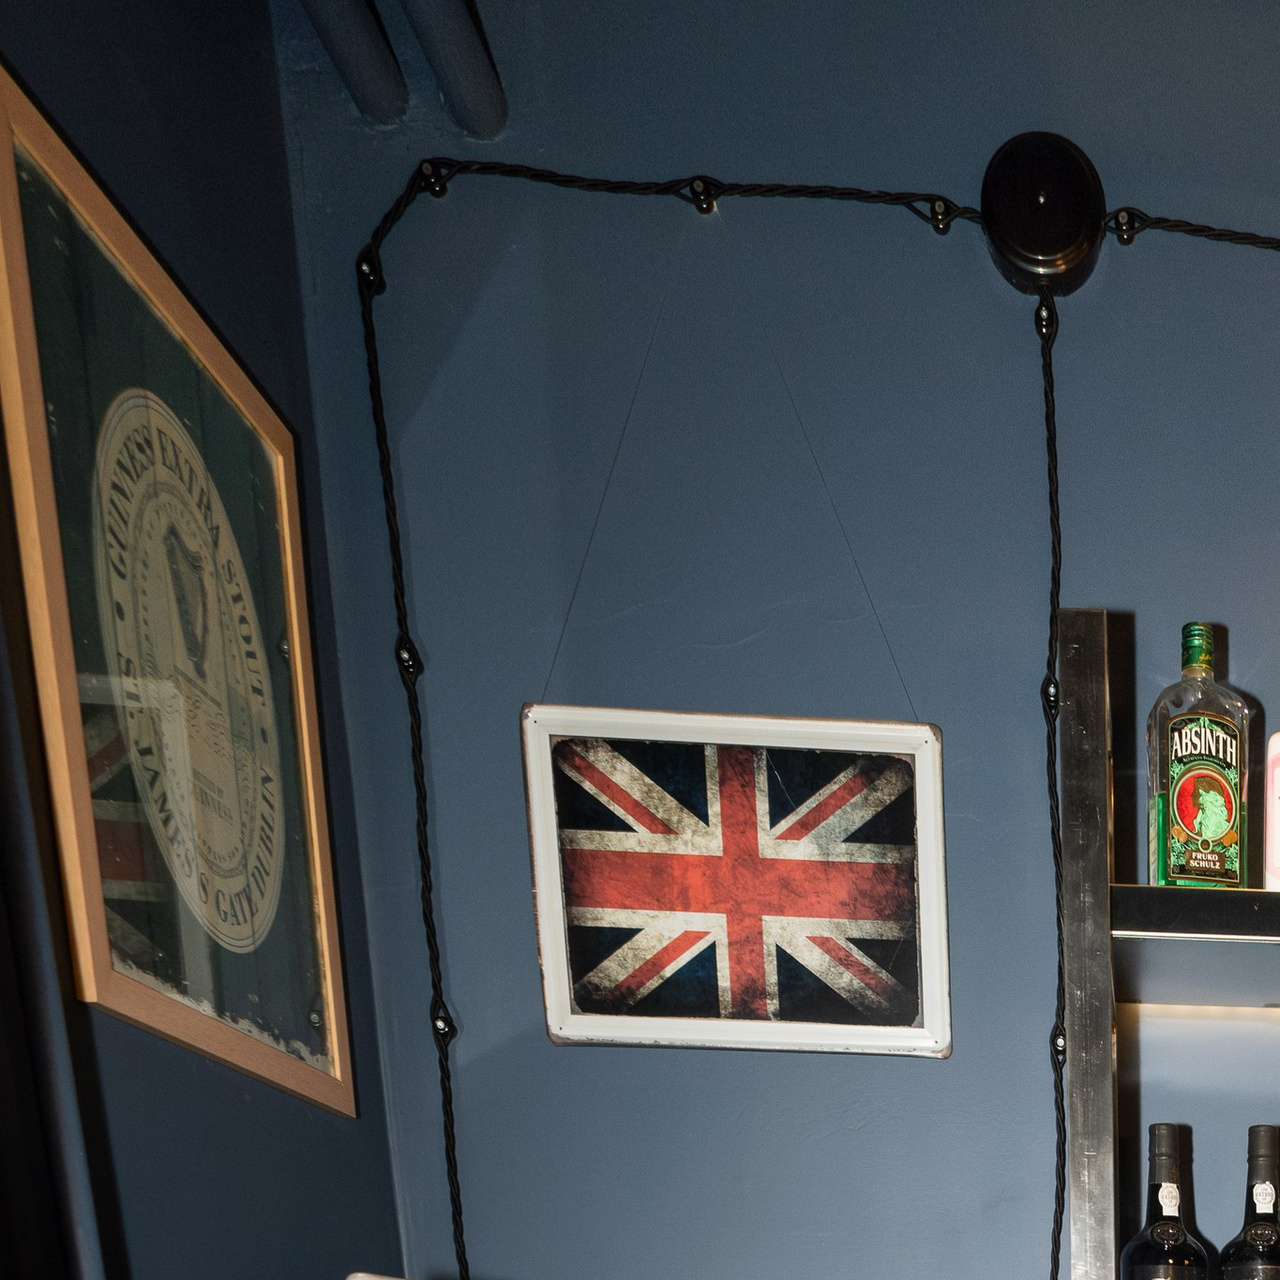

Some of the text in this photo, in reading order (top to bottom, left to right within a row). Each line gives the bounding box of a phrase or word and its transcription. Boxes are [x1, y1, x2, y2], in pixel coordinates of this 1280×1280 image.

[107, 423, 267, 706] GUINNESS EXTRA STOUT
[1171, 727, 1237, 767] ABSINTH
[215, 880, 260, 926] GATE
[253, 764, 276, 899] DUBLIN
[1189, 859, 1221, 870] SCHULZ
[1191, 852, 1219, 862] FRUKO
